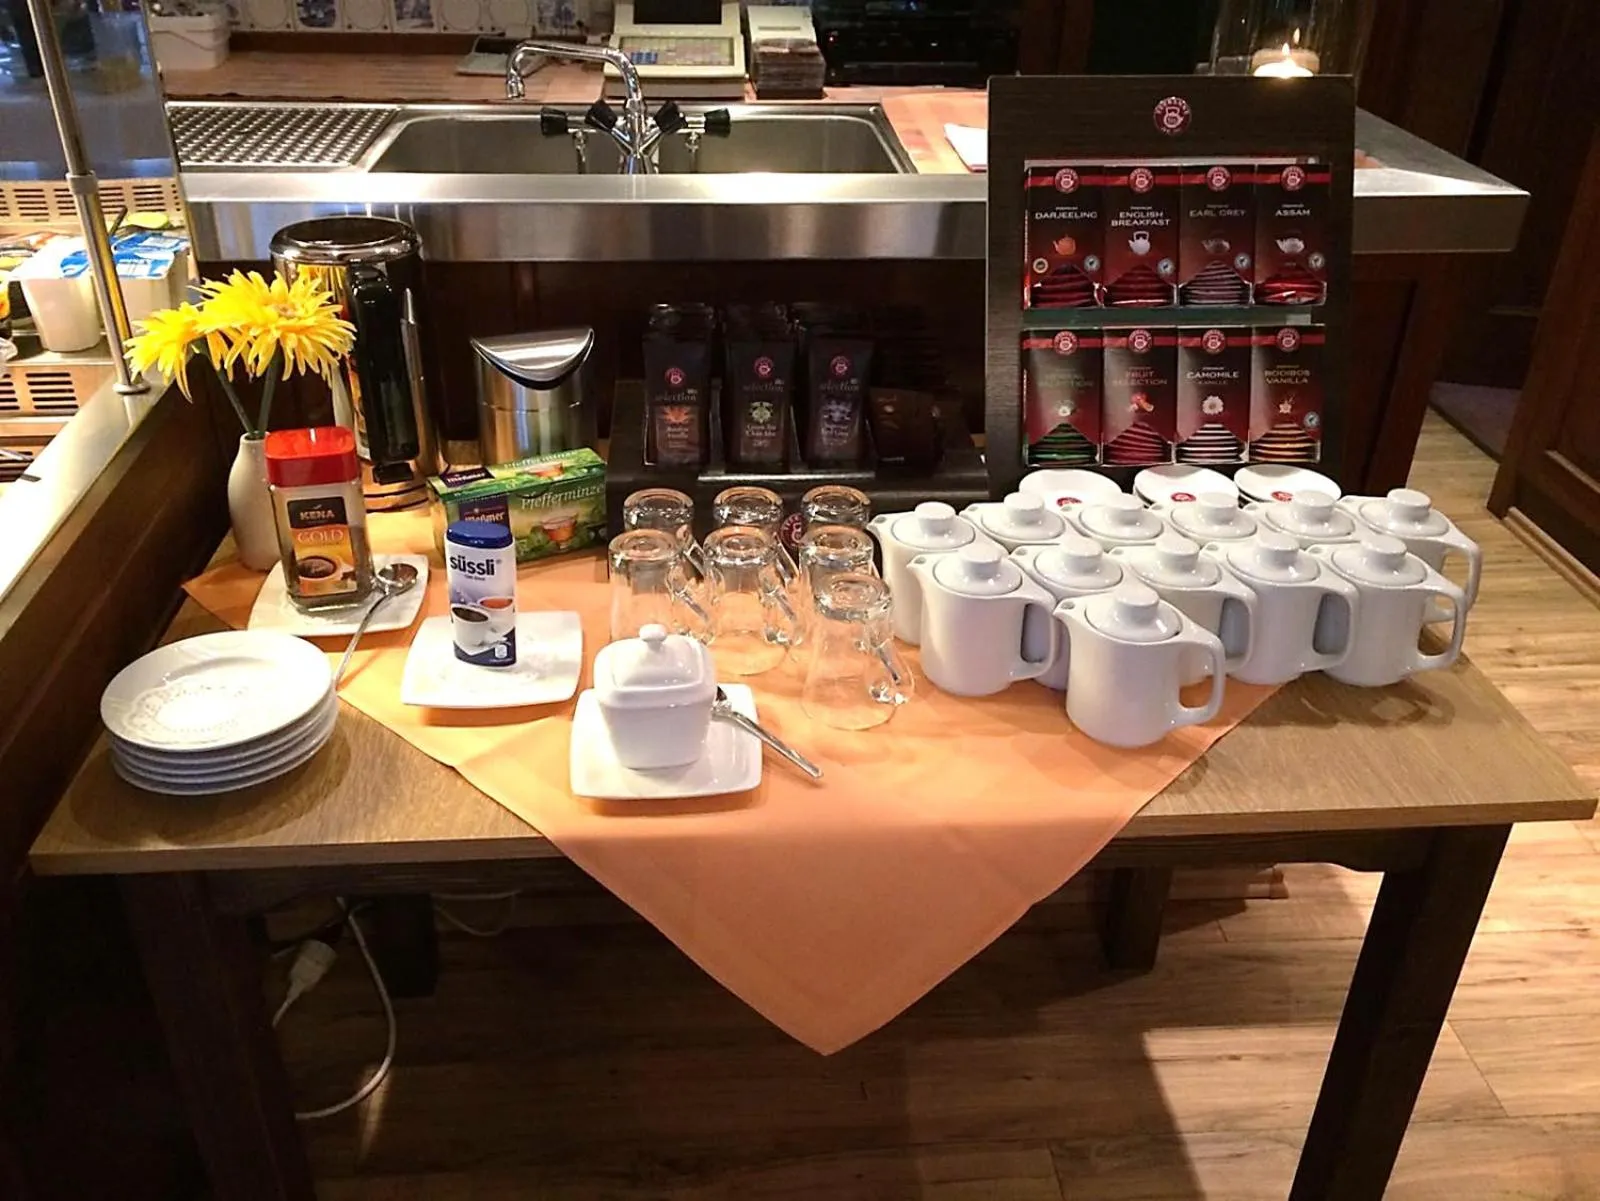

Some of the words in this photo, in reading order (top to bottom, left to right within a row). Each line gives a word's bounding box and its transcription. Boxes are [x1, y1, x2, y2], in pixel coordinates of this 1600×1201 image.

[1035, 211, 1098, 219] DARJEELING
[1189, 209, 1216, 217] EARL
[1111, 218, 1171, 227] BREAKFAST
[1186, 371, 1240, 379] CAMOMILE
[450, 555, 495, 576] süssli
